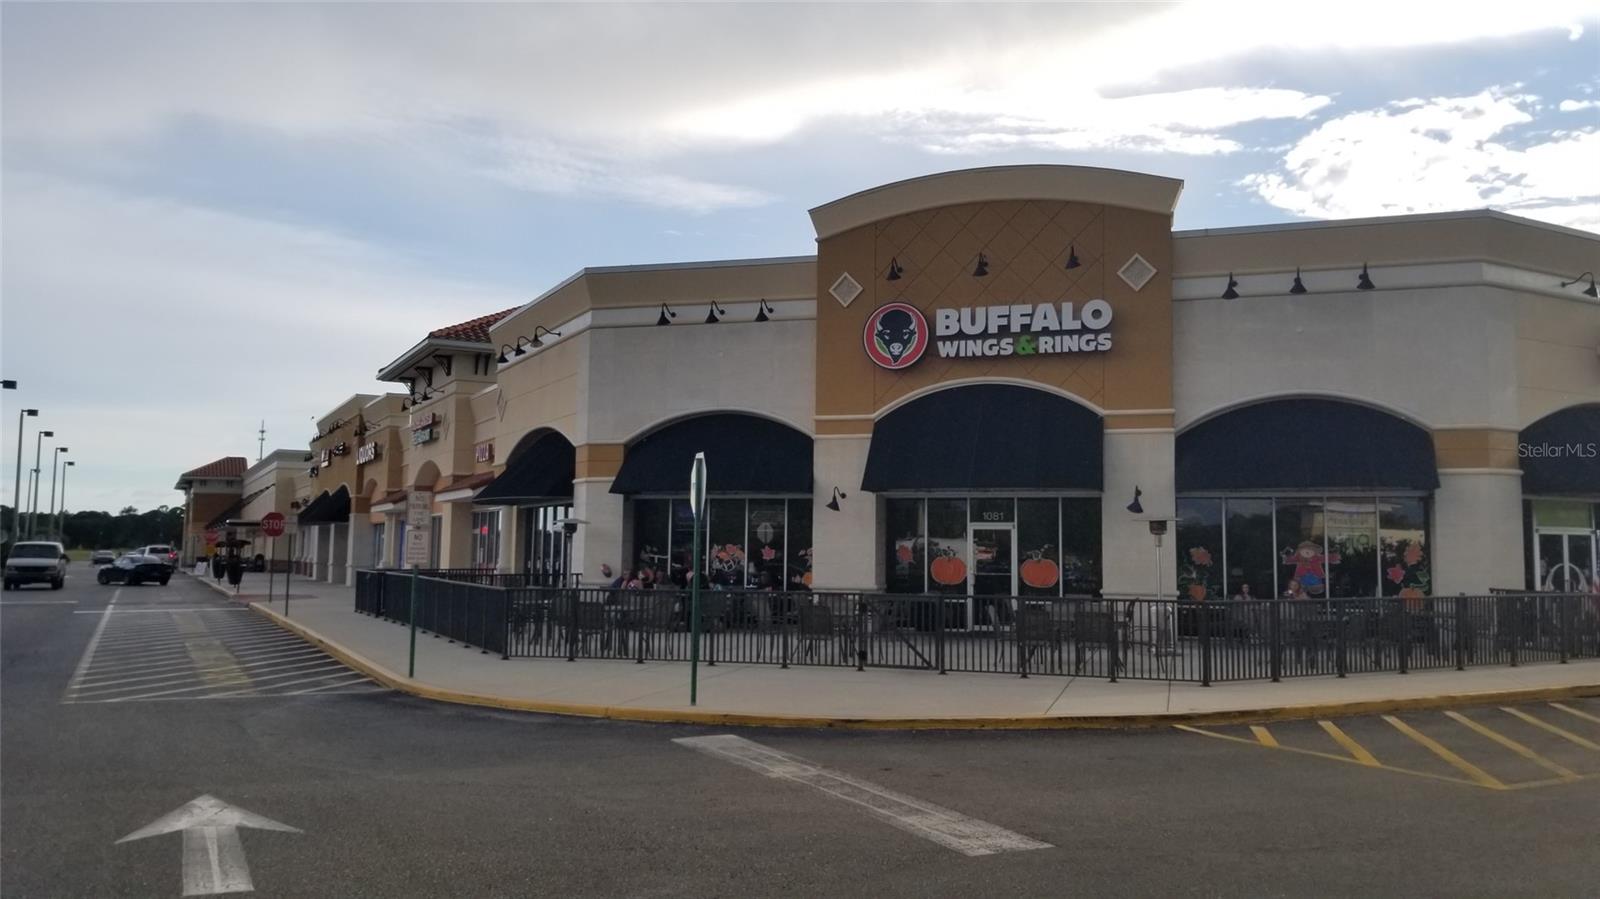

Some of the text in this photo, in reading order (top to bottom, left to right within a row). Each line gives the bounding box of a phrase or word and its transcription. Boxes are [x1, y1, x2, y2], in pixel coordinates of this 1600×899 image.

[936, 299, 1112, 336] BUFFALO
[937, 338, 1014, 358] WINGS
[1038, 334, 1112, 354] RINGS
[262, 519, 285, 529] STOP
[982, 511, 1004, 520] 1081
